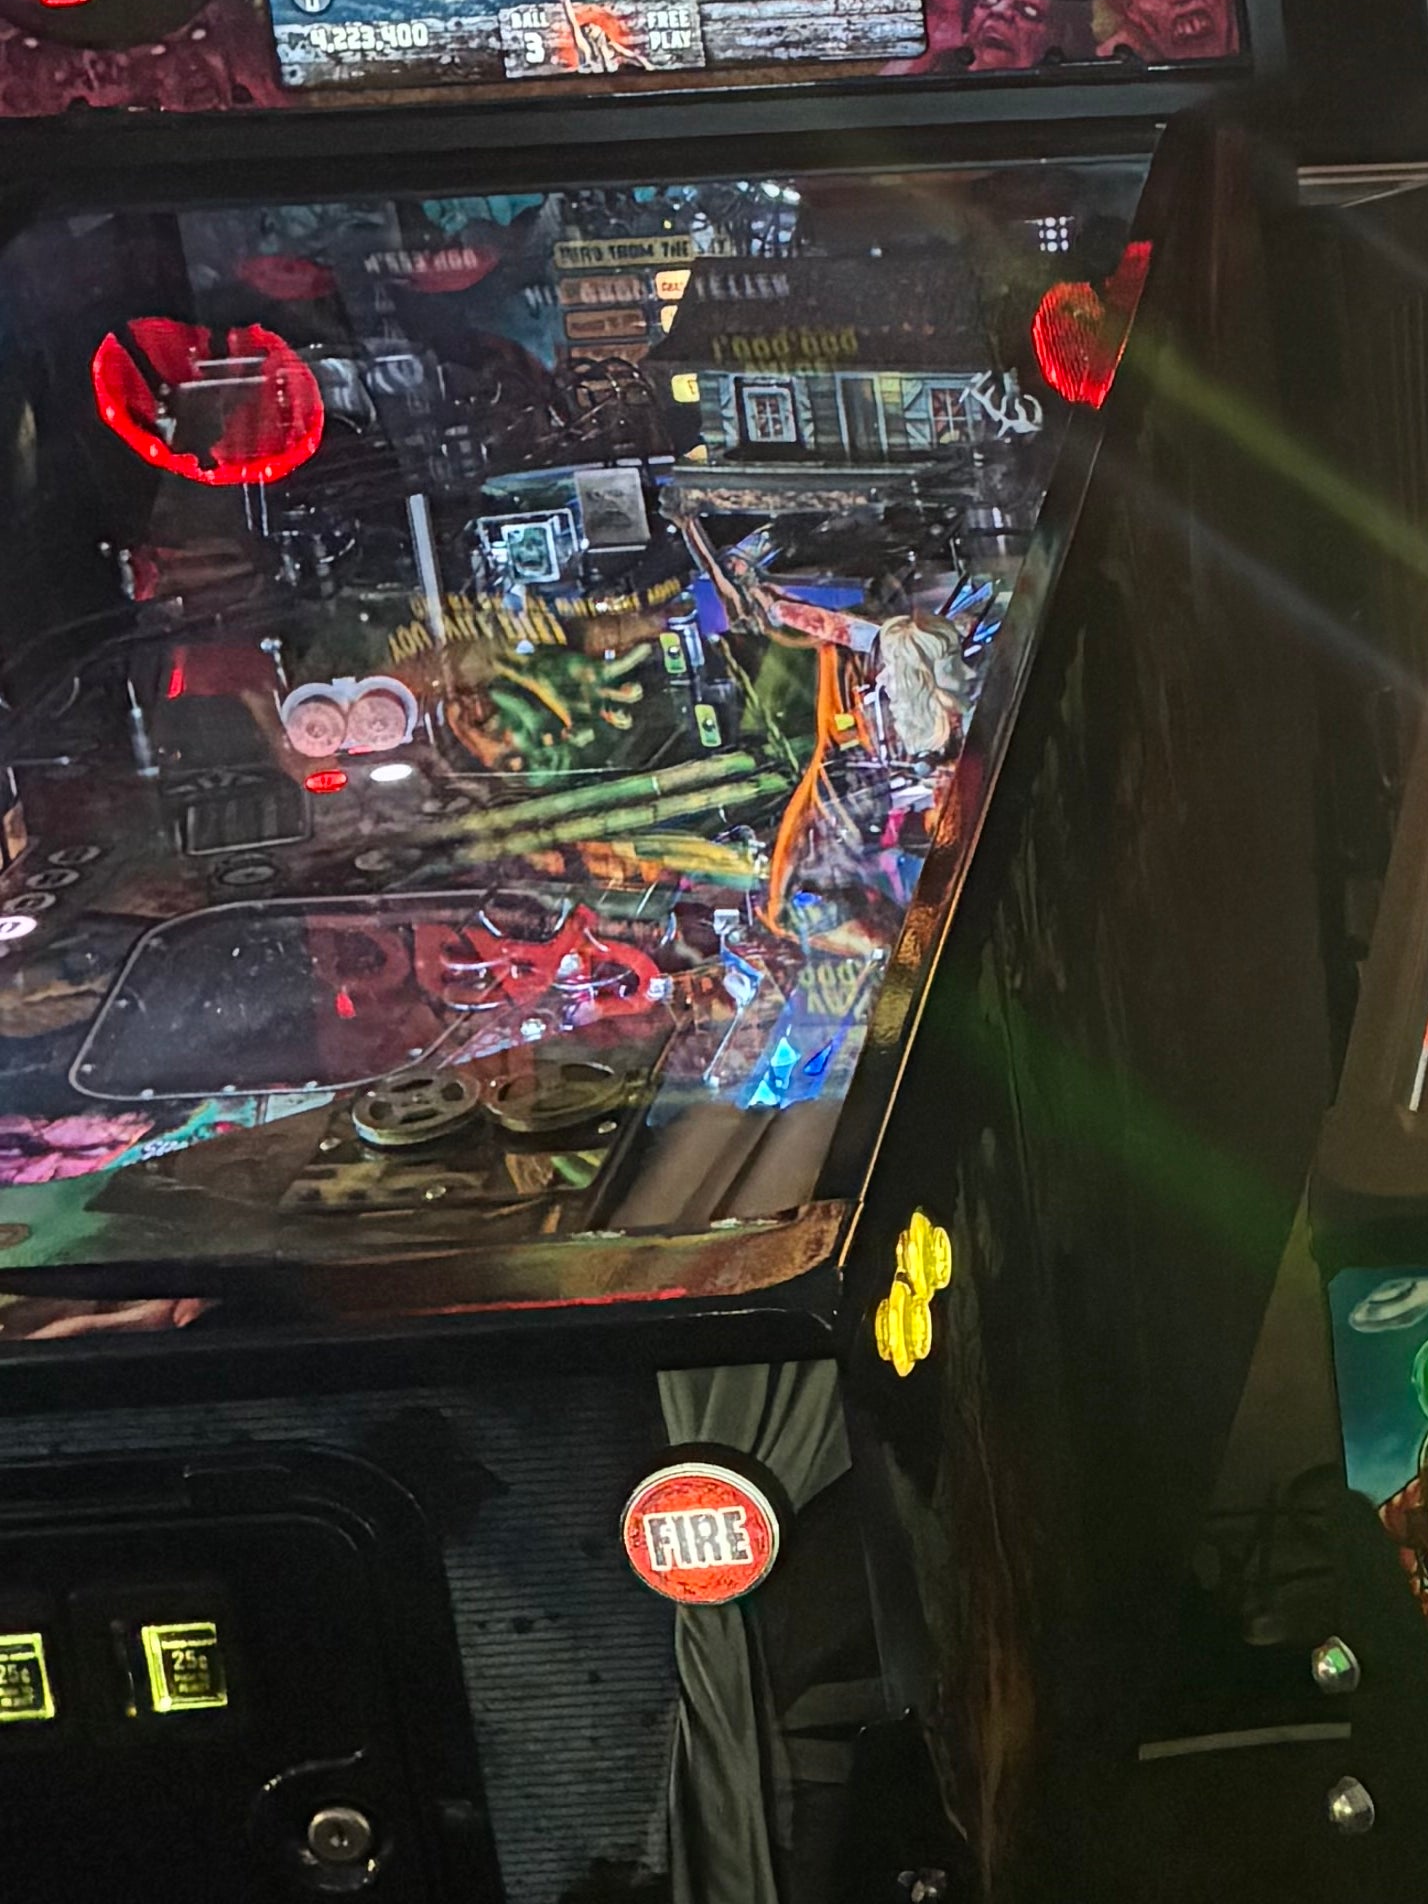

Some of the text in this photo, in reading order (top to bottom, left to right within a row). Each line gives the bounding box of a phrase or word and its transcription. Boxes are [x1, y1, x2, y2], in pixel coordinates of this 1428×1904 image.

[511, 12, 548, 29] BALL
[646, 10, 691, 29] FREE
[309, 22, 429, 53] 4,223,400
[523, 33, 545, 64] 3
[649, 30, 692, 50] PLAY
[647, 1510, 750, 1567] FIRE
